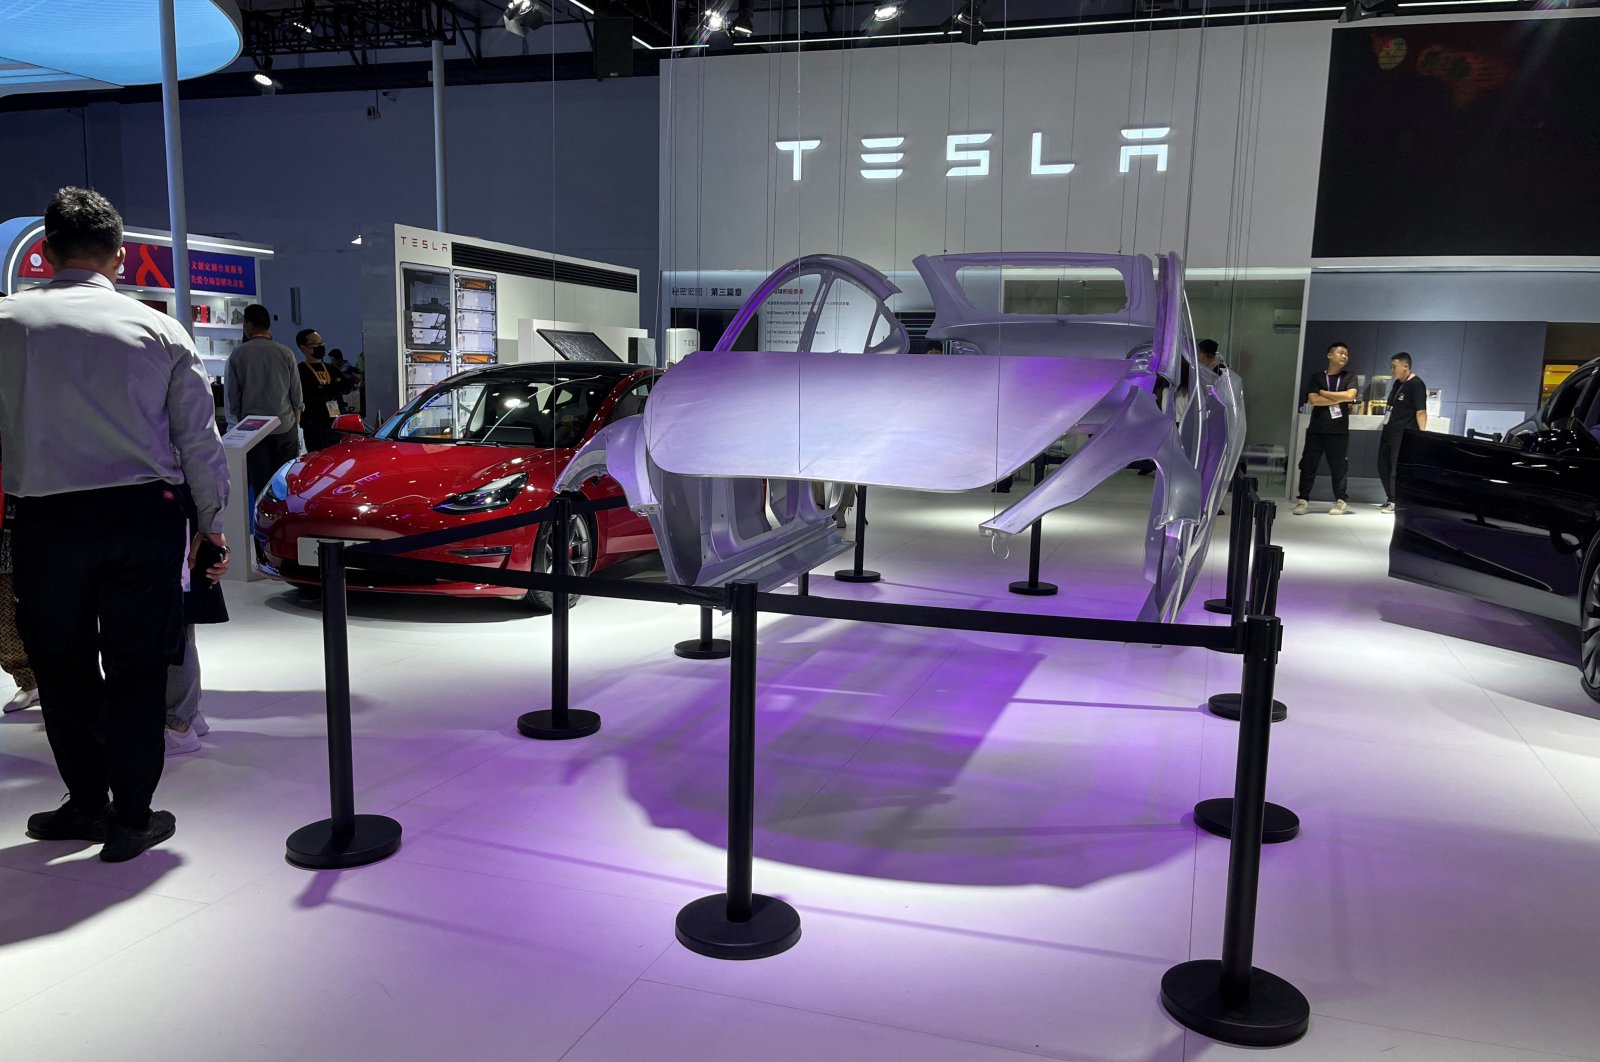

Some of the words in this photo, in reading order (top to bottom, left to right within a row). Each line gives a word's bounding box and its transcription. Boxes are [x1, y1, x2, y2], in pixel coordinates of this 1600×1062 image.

[775, 126, 1170, 181] TESLA
[400, 236, 448, 253] TESLA
[710, 287, 742, 297] 第三篇章
